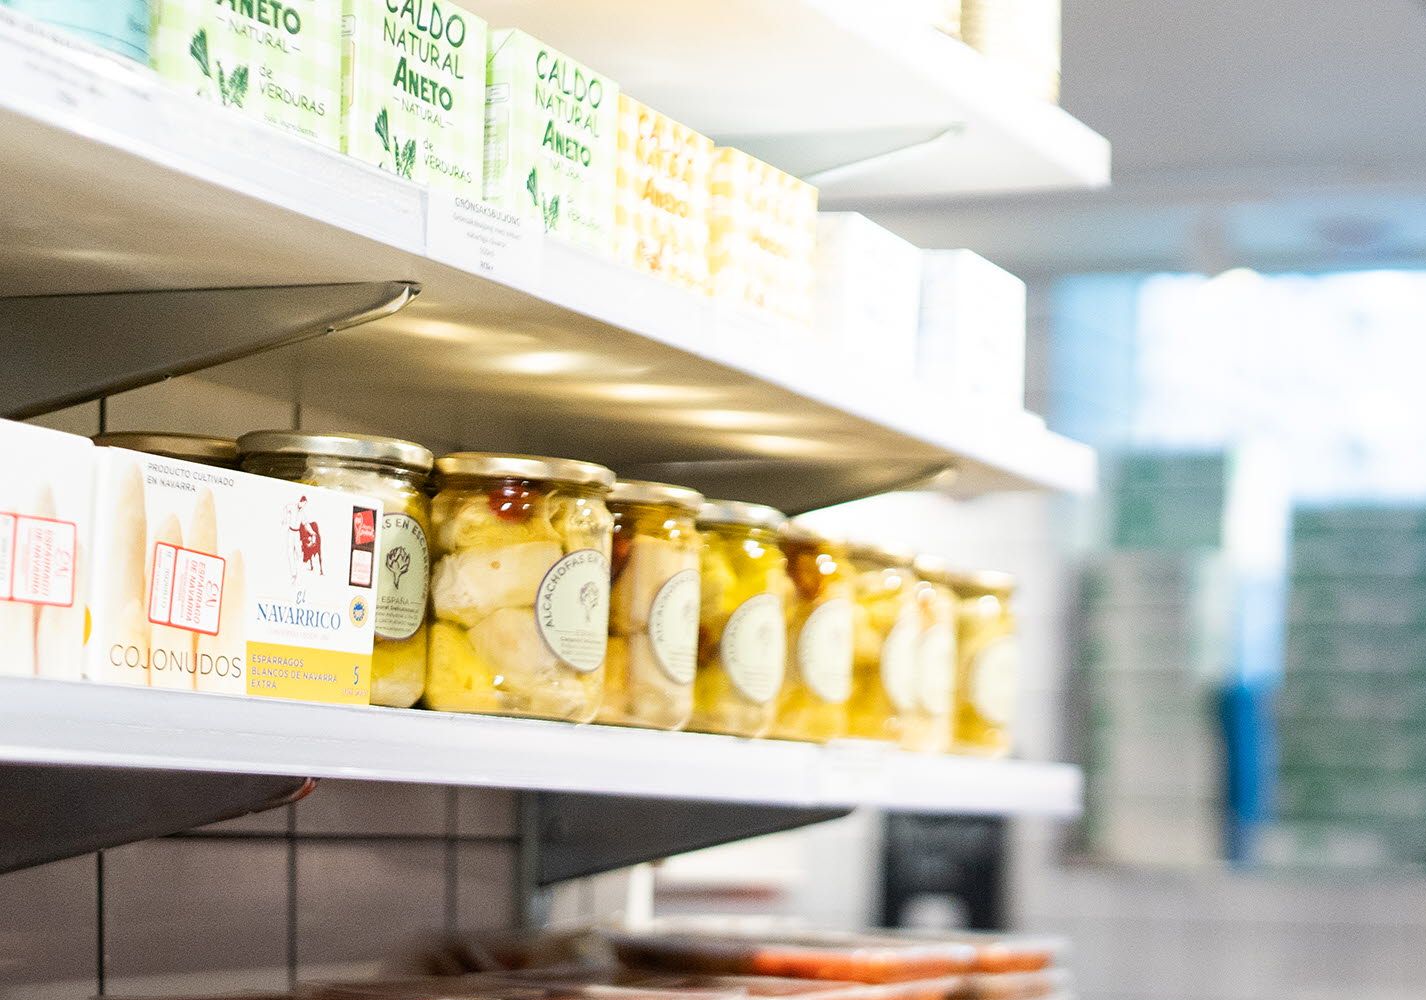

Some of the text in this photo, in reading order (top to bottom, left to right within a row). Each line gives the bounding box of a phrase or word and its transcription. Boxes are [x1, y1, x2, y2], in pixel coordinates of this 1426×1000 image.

[216, 0, 301, 34] NETO
[383, 16, 465, 80] NATURAL
[393, 56, 454, 112] ANETO
[536, 50, 603, 109] CALDO
[259, 80, 325, 116] VERDURAS
[535, 82, 601, 138] NATURAL
[542, 119, 591, 168] ANETO
[423, 151, 473, 185] VERDURAS
[148, 463, 235, 487] PRODUCTO CULTIVADO
[160, 480, 196, 492] NAVARRA
[396, 518, 409, 530] EN
[543, 554, 585, 628] ALCACHOFAS
[257, 603, 341, 630] NAVARRICO
[109, 643, 242, 679] COJONUDOS
[251, 666, 338, 683] BLANCOS DE NAVARRA
[251, 679, 277, 689] EXTRA
